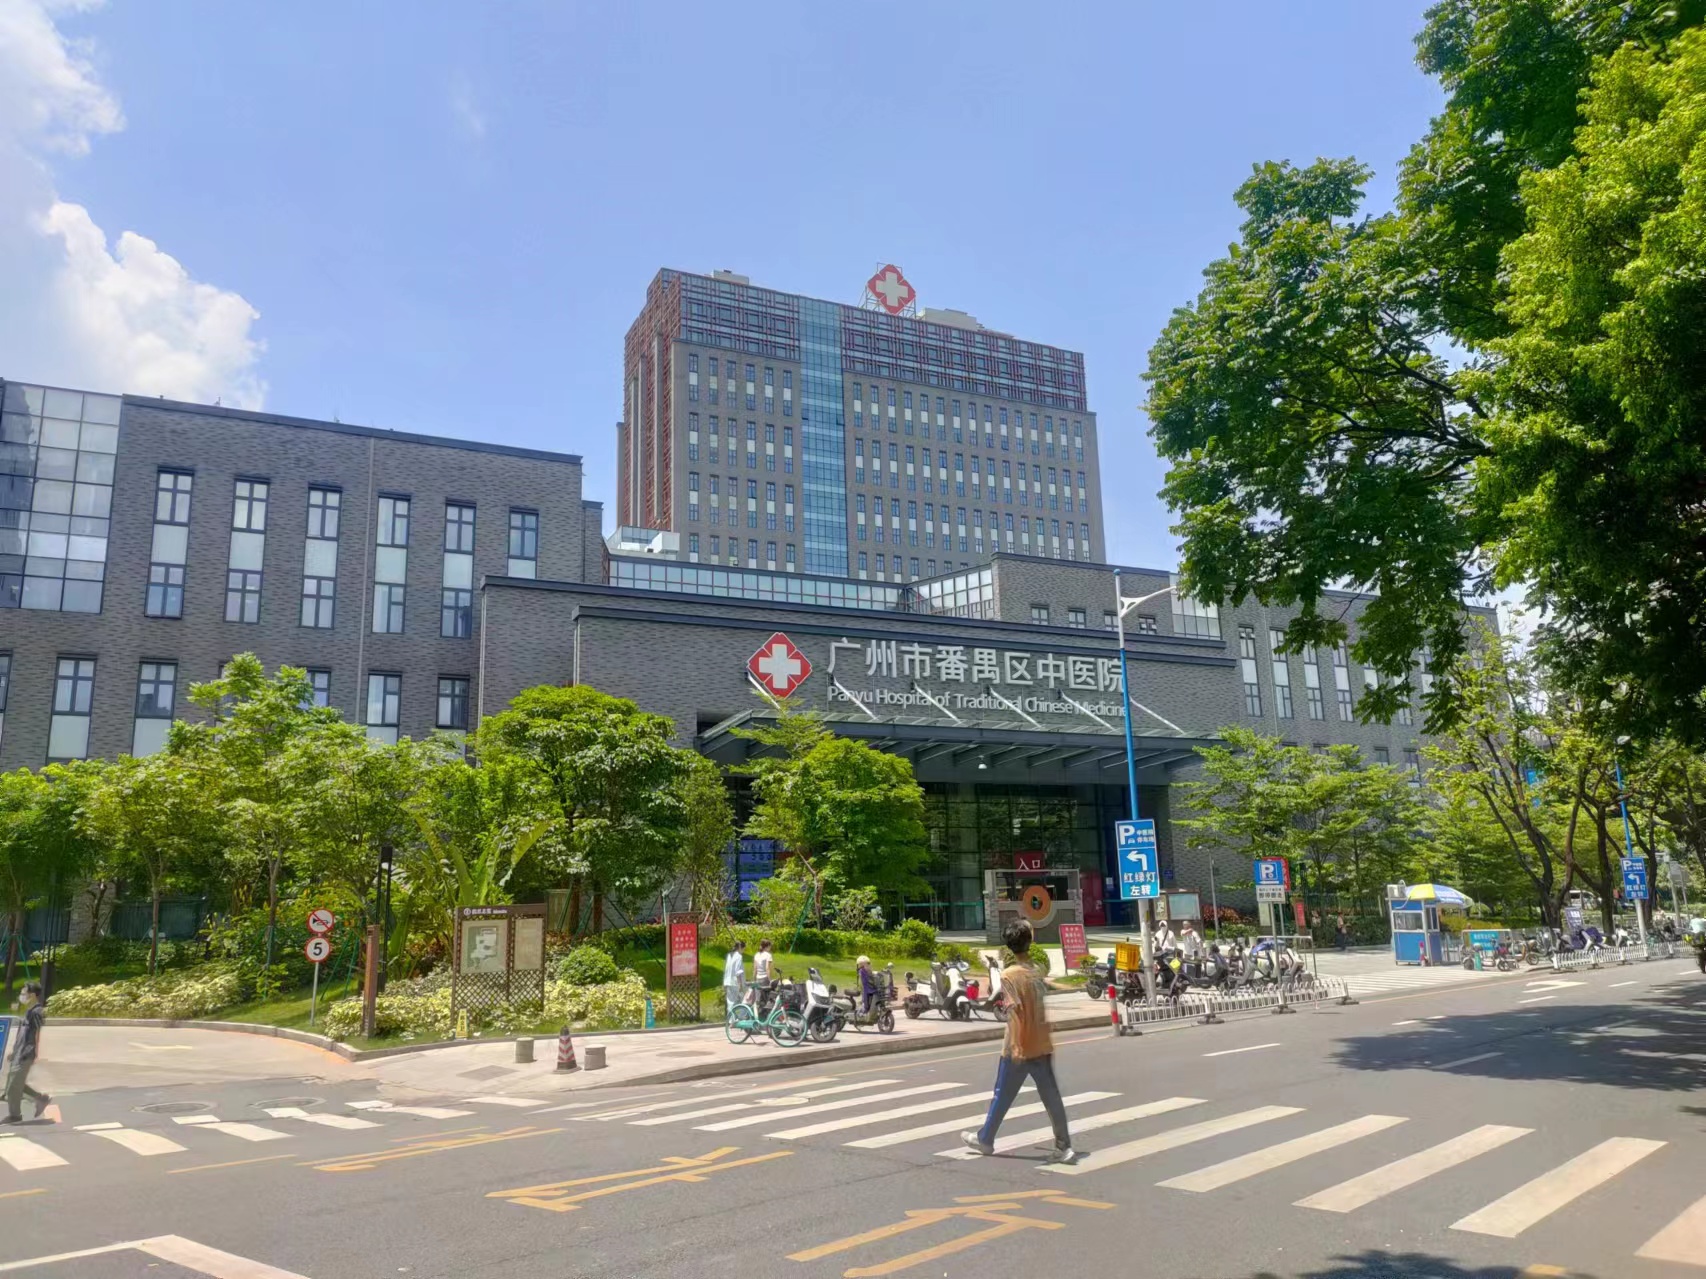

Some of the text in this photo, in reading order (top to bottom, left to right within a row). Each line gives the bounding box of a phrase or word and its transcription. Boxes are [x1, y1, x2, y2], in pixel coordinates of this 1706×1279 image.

[827, 637, 1123, 692] 广州市番禺区中医院
[828, 686, 873, 706] Panyu
[876, 688, 931, 709] Hospital
[935, 691, 950, 703] of
[953, 693, 1022, 710] Traditional
[1025, 696, 1072, 714] Chinese
[1119, 825, 1135, 845] P
[1018, 857, 1040, 871] 入口
[1261, 864, 1274, 878] P
[1623, 860, 1632, 871] P
[1124, 871, 1155, 883] 红绿灯
[1130, 884, 1151, 896] 左转
[313, 942, 323, 956] 5
